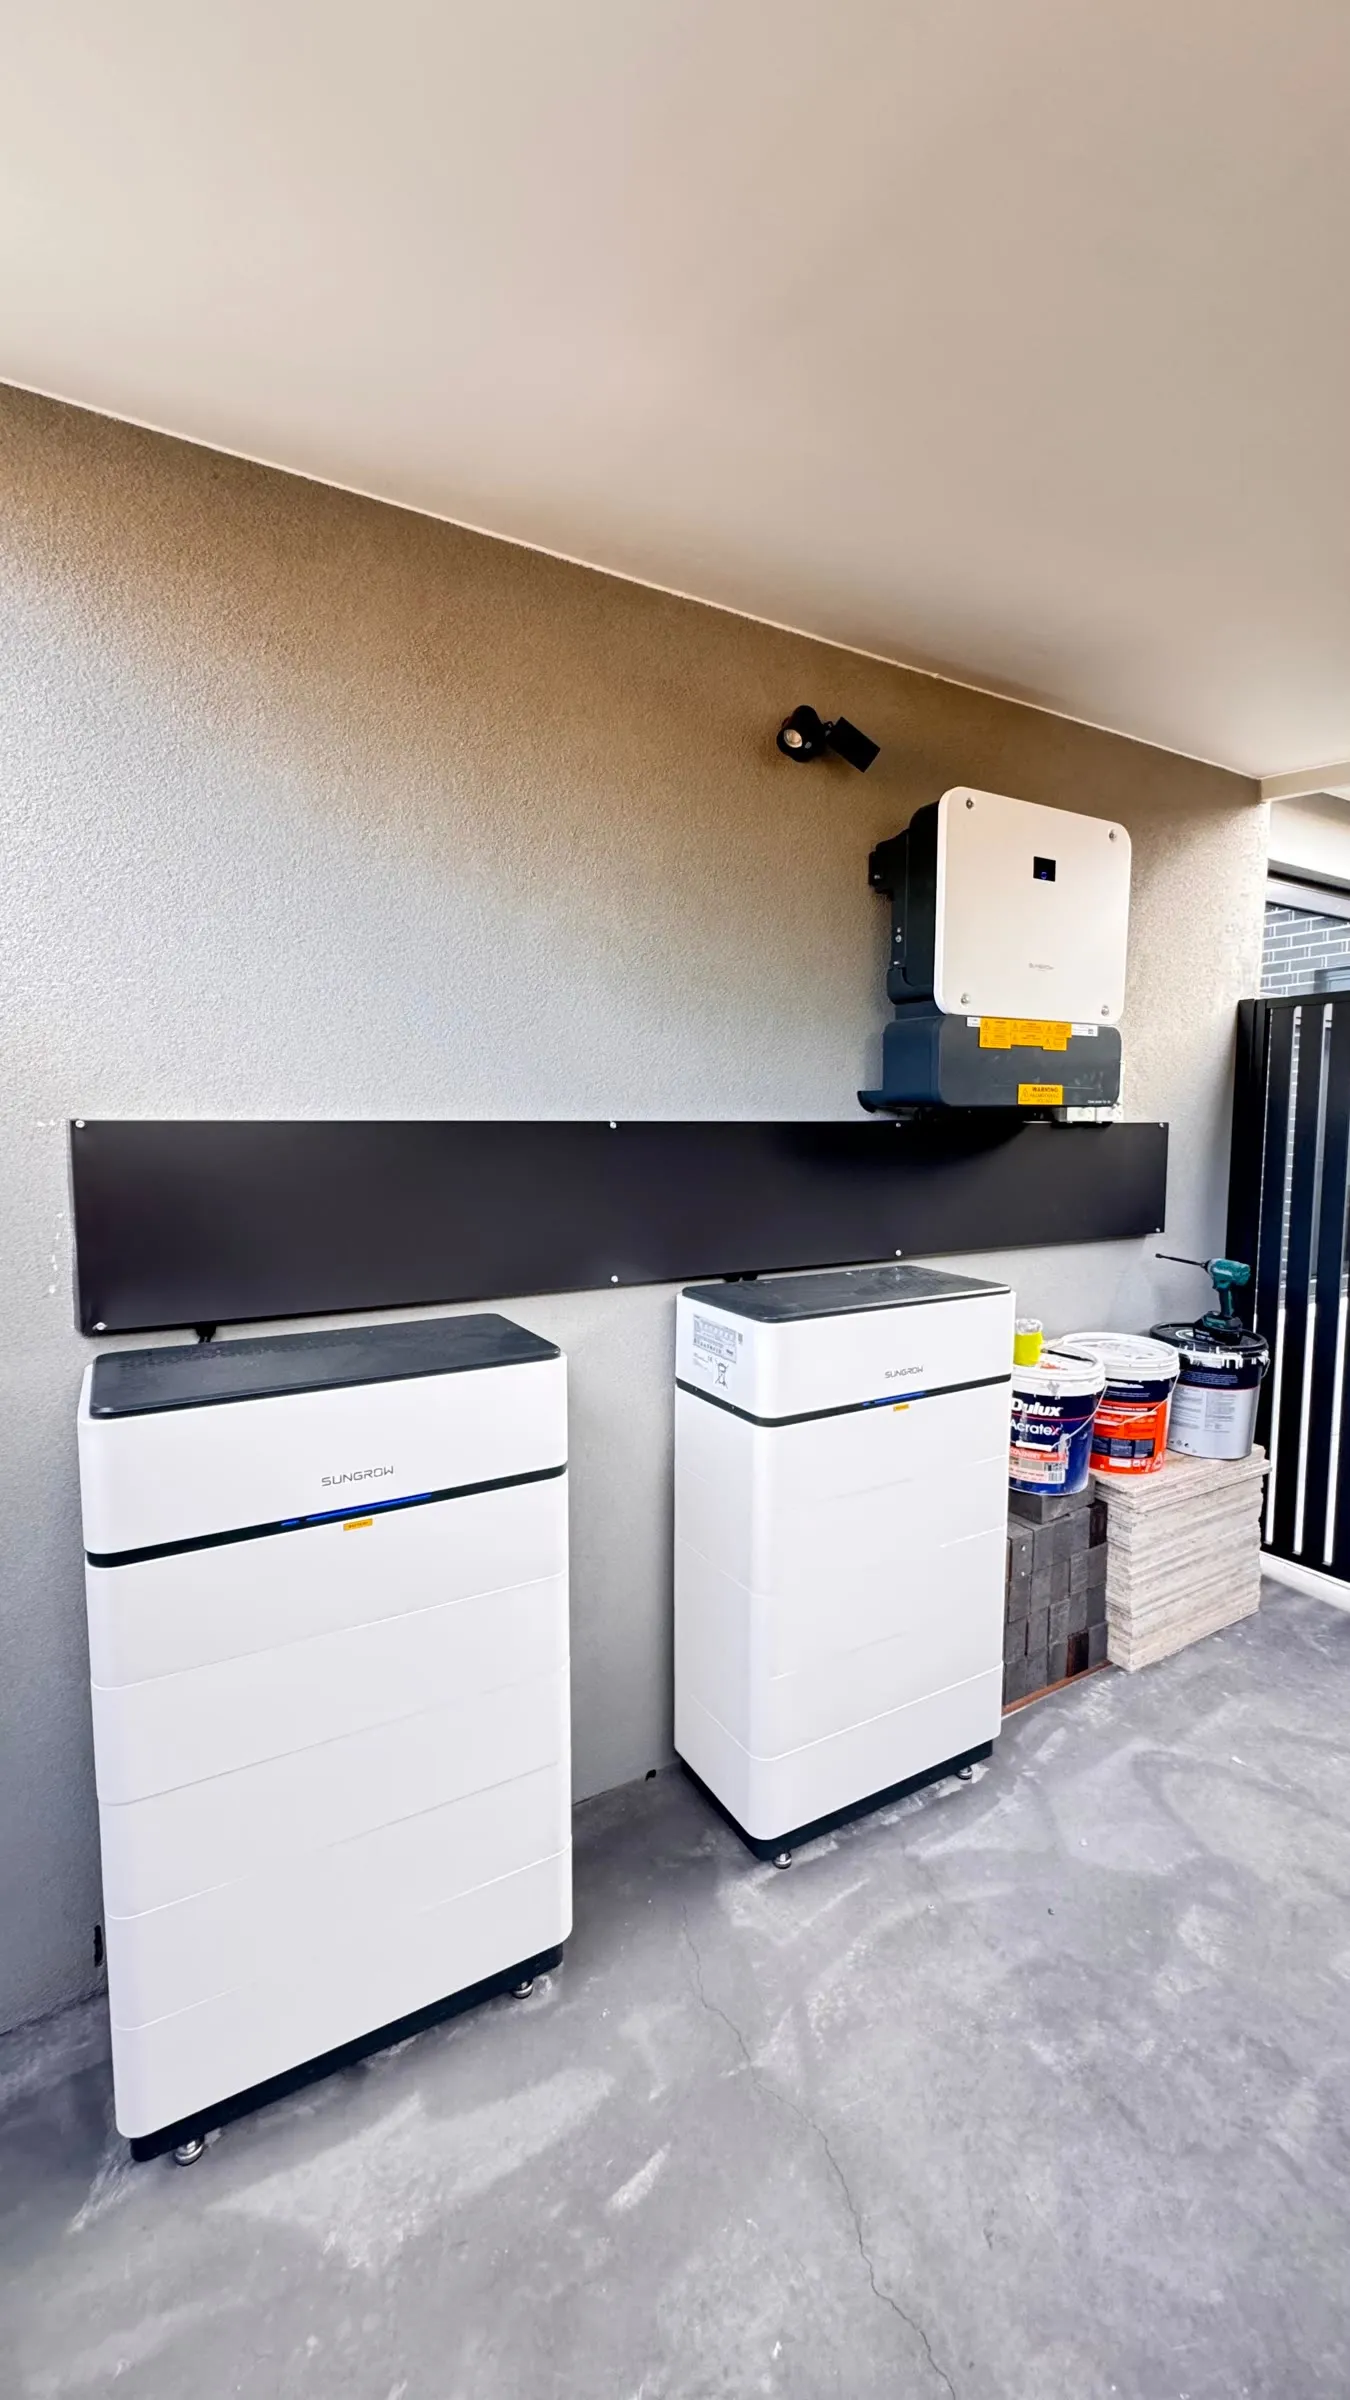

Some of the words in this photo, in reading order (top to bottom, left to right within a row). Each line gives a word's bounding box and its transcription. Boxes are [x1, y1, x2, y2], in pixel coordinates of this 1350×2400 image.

[884, 1365, 924, 1379] SUNGROW
[1011, 1397, 1060, 1417] Dulux
[1010, 1419, 1060, 1436] Acratex
[321, 1465, 394, 1487] SUNGROW
